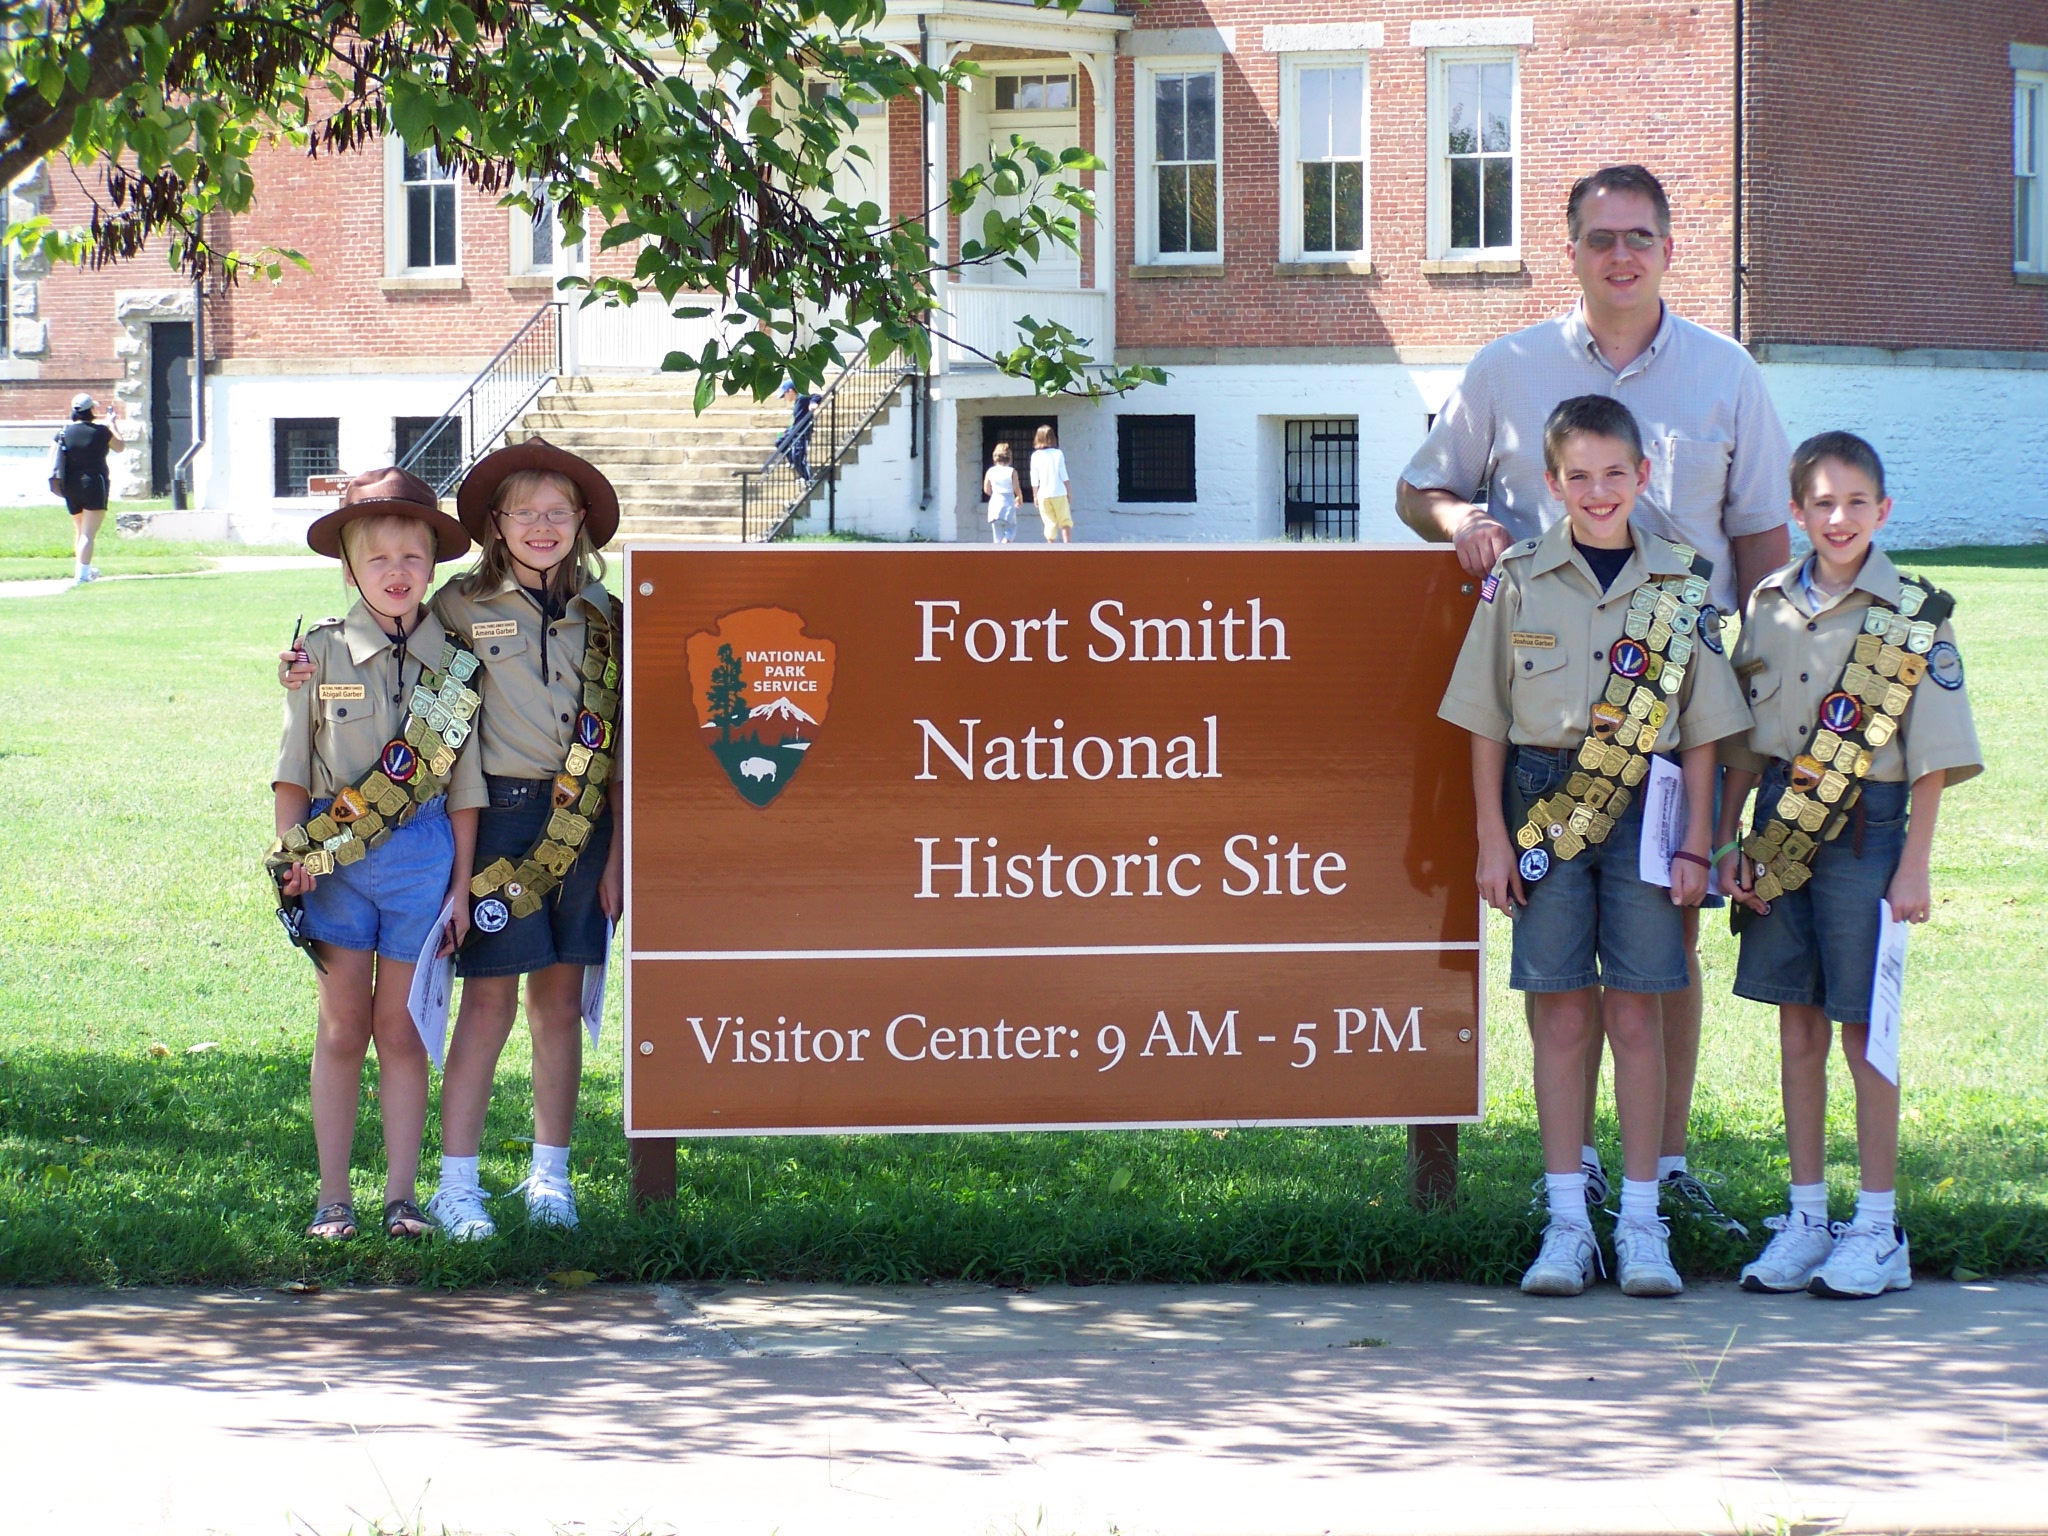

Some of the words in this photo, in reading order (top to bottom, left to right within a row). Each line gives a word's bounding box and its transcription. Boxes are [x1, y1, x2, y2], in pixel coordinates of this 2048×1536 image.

[914, 600, 1069, 663] Fort
[1088, 597, 1291, 663] Smith
[746, 651, 825, 662] NATIONAL
[765, 665, 806, 677] PARK
[322, 691, 342, 699] Abigail
[753, 681, 817, 692] SERVICE
[913, 715, 1223, 781] National
[913, 836, 1202, 899] Historic
[1222, 834, 1347, 897] Site
[686, 1016, 871, 1064] Visitor
[885, 1013, 1079, 1061] Center:
[1096, 1024, 1126, 1072] 9
[1139, 1010, 1243, 1057] AM
[1258, 1034, 1276, 1042] -
[1290, 1023, 1317, 1069] 5
[1333, 1006, 1427, 1054] PM
